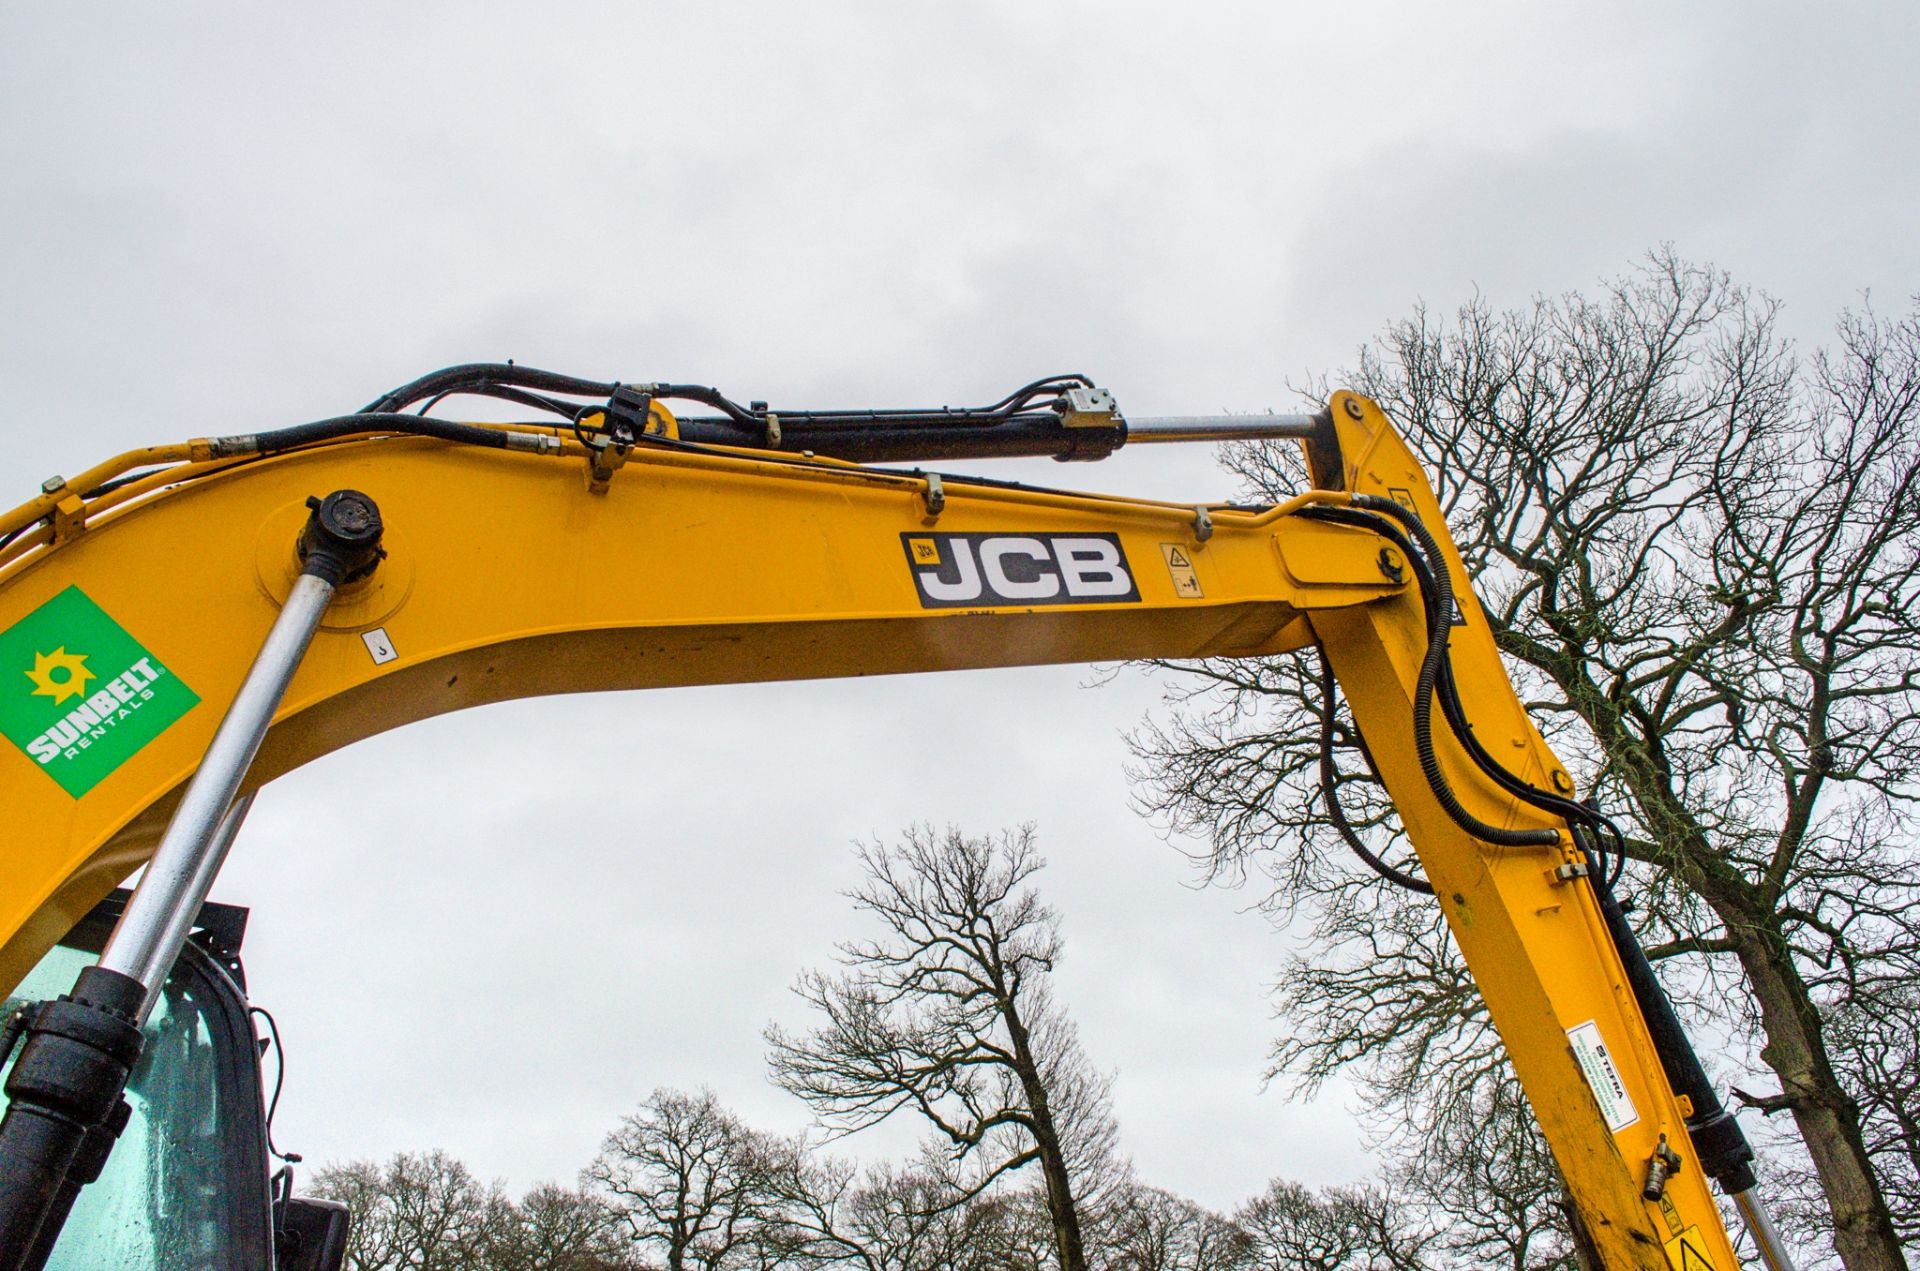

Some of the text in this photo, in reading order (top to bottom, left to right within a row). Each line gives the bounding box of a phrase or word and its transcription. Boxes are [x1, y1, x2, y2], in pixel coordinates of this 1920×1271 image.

[919, 538, 1131, 600] JCB
[64, 689, 154, 760] RENTALS
[1603, 1059, 1623, 1099] TEFRA
